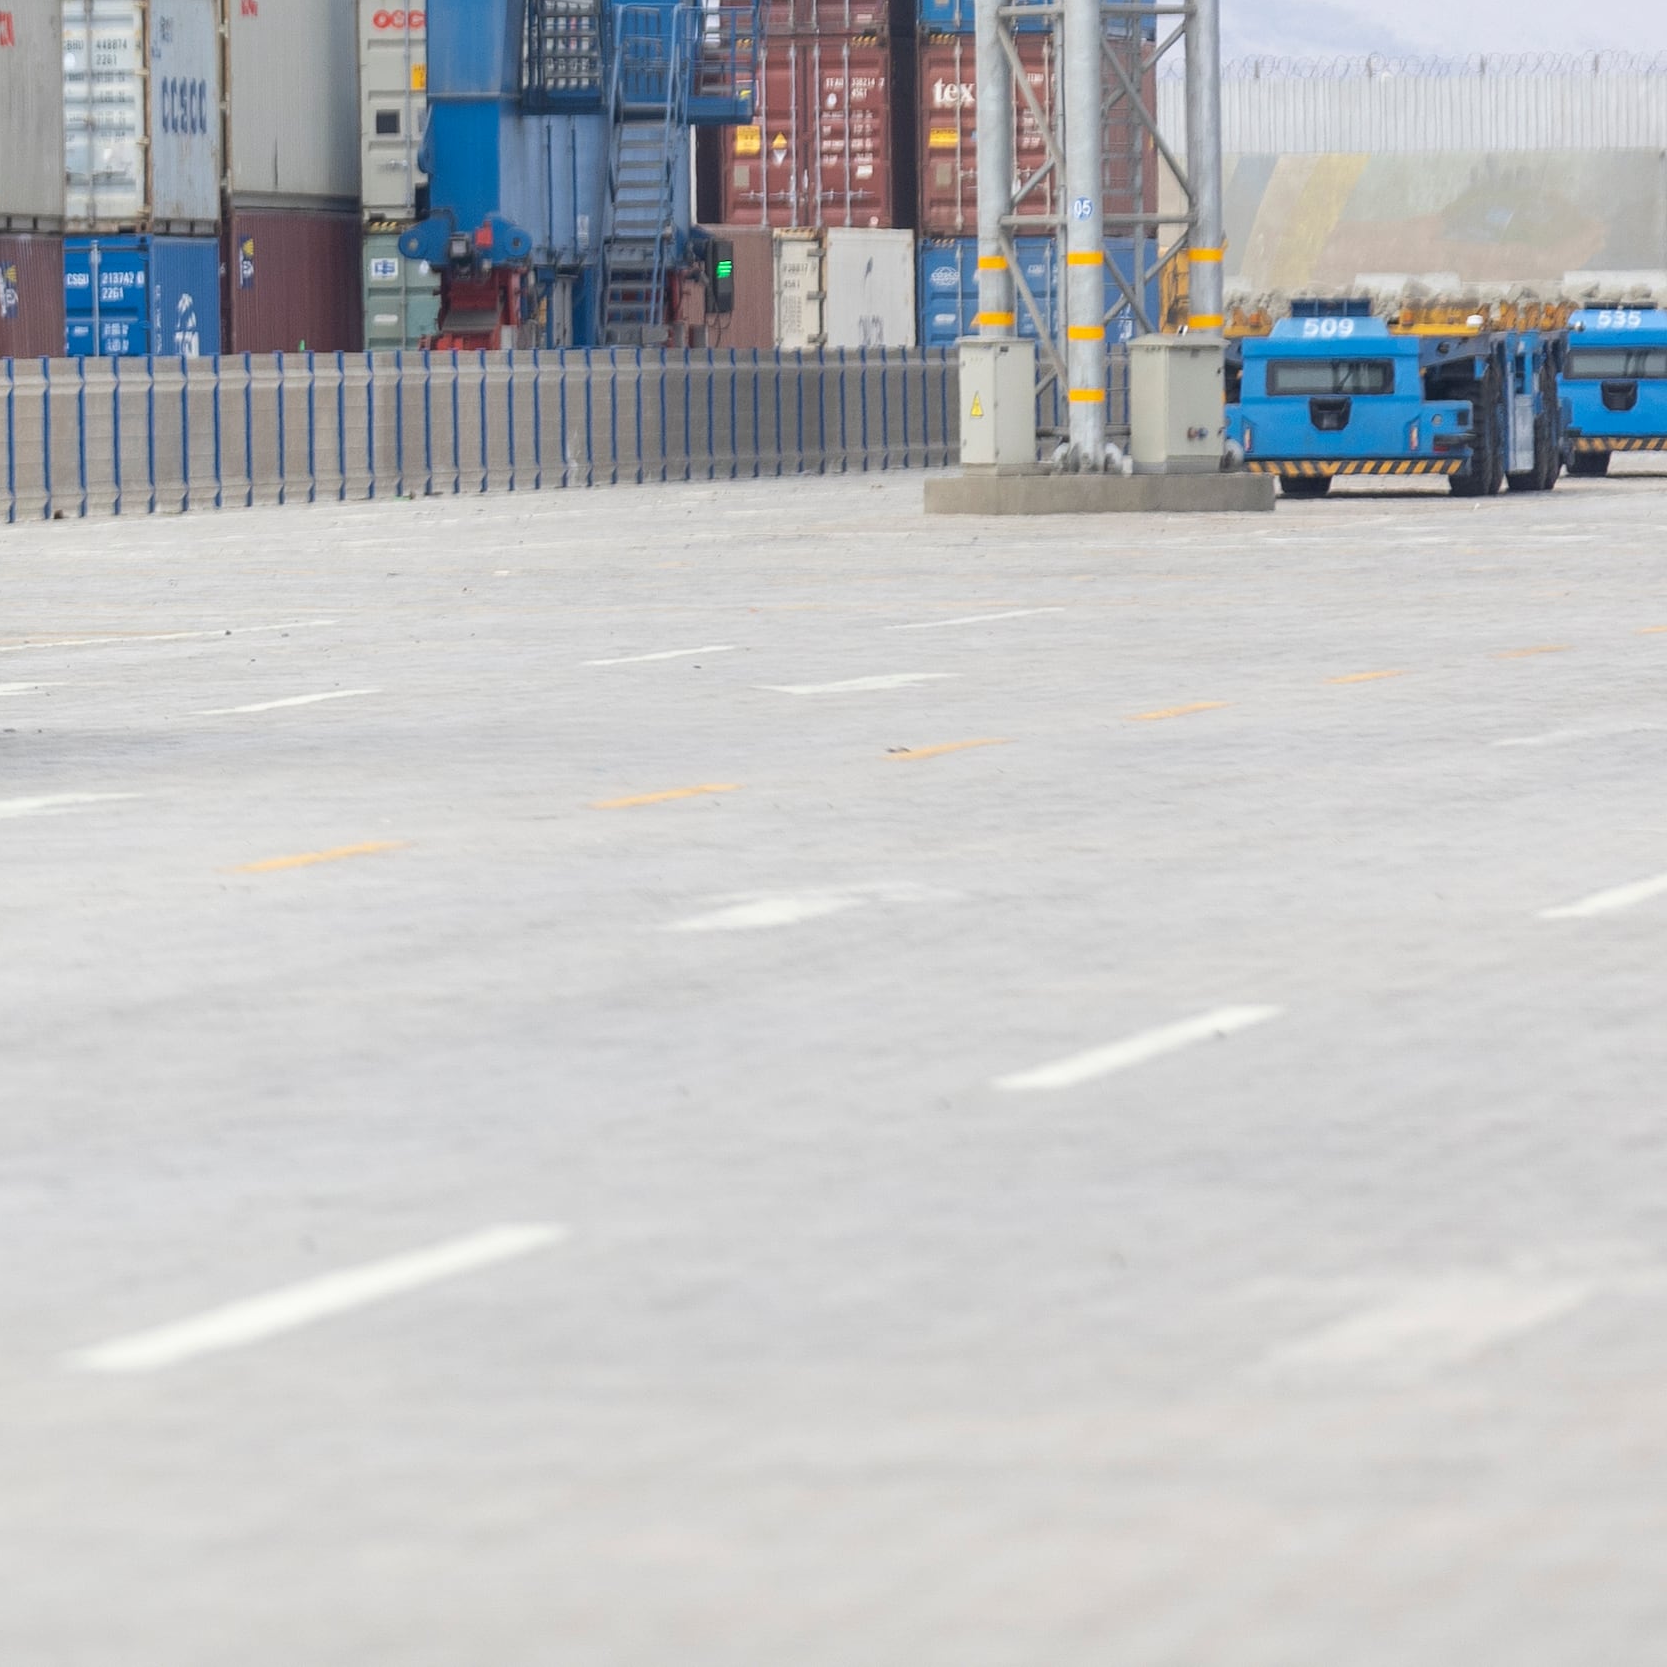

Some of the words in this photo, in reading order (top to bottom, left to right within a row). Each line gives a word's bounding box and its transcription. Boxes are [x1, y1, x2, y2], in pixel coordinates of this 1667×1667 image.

[933, 77, 975, 103] tex
[1073, 199, 1091, 217] 05
[1302, 318, 1355, 338] 509
[1595, 310, 1642, 330] 535
